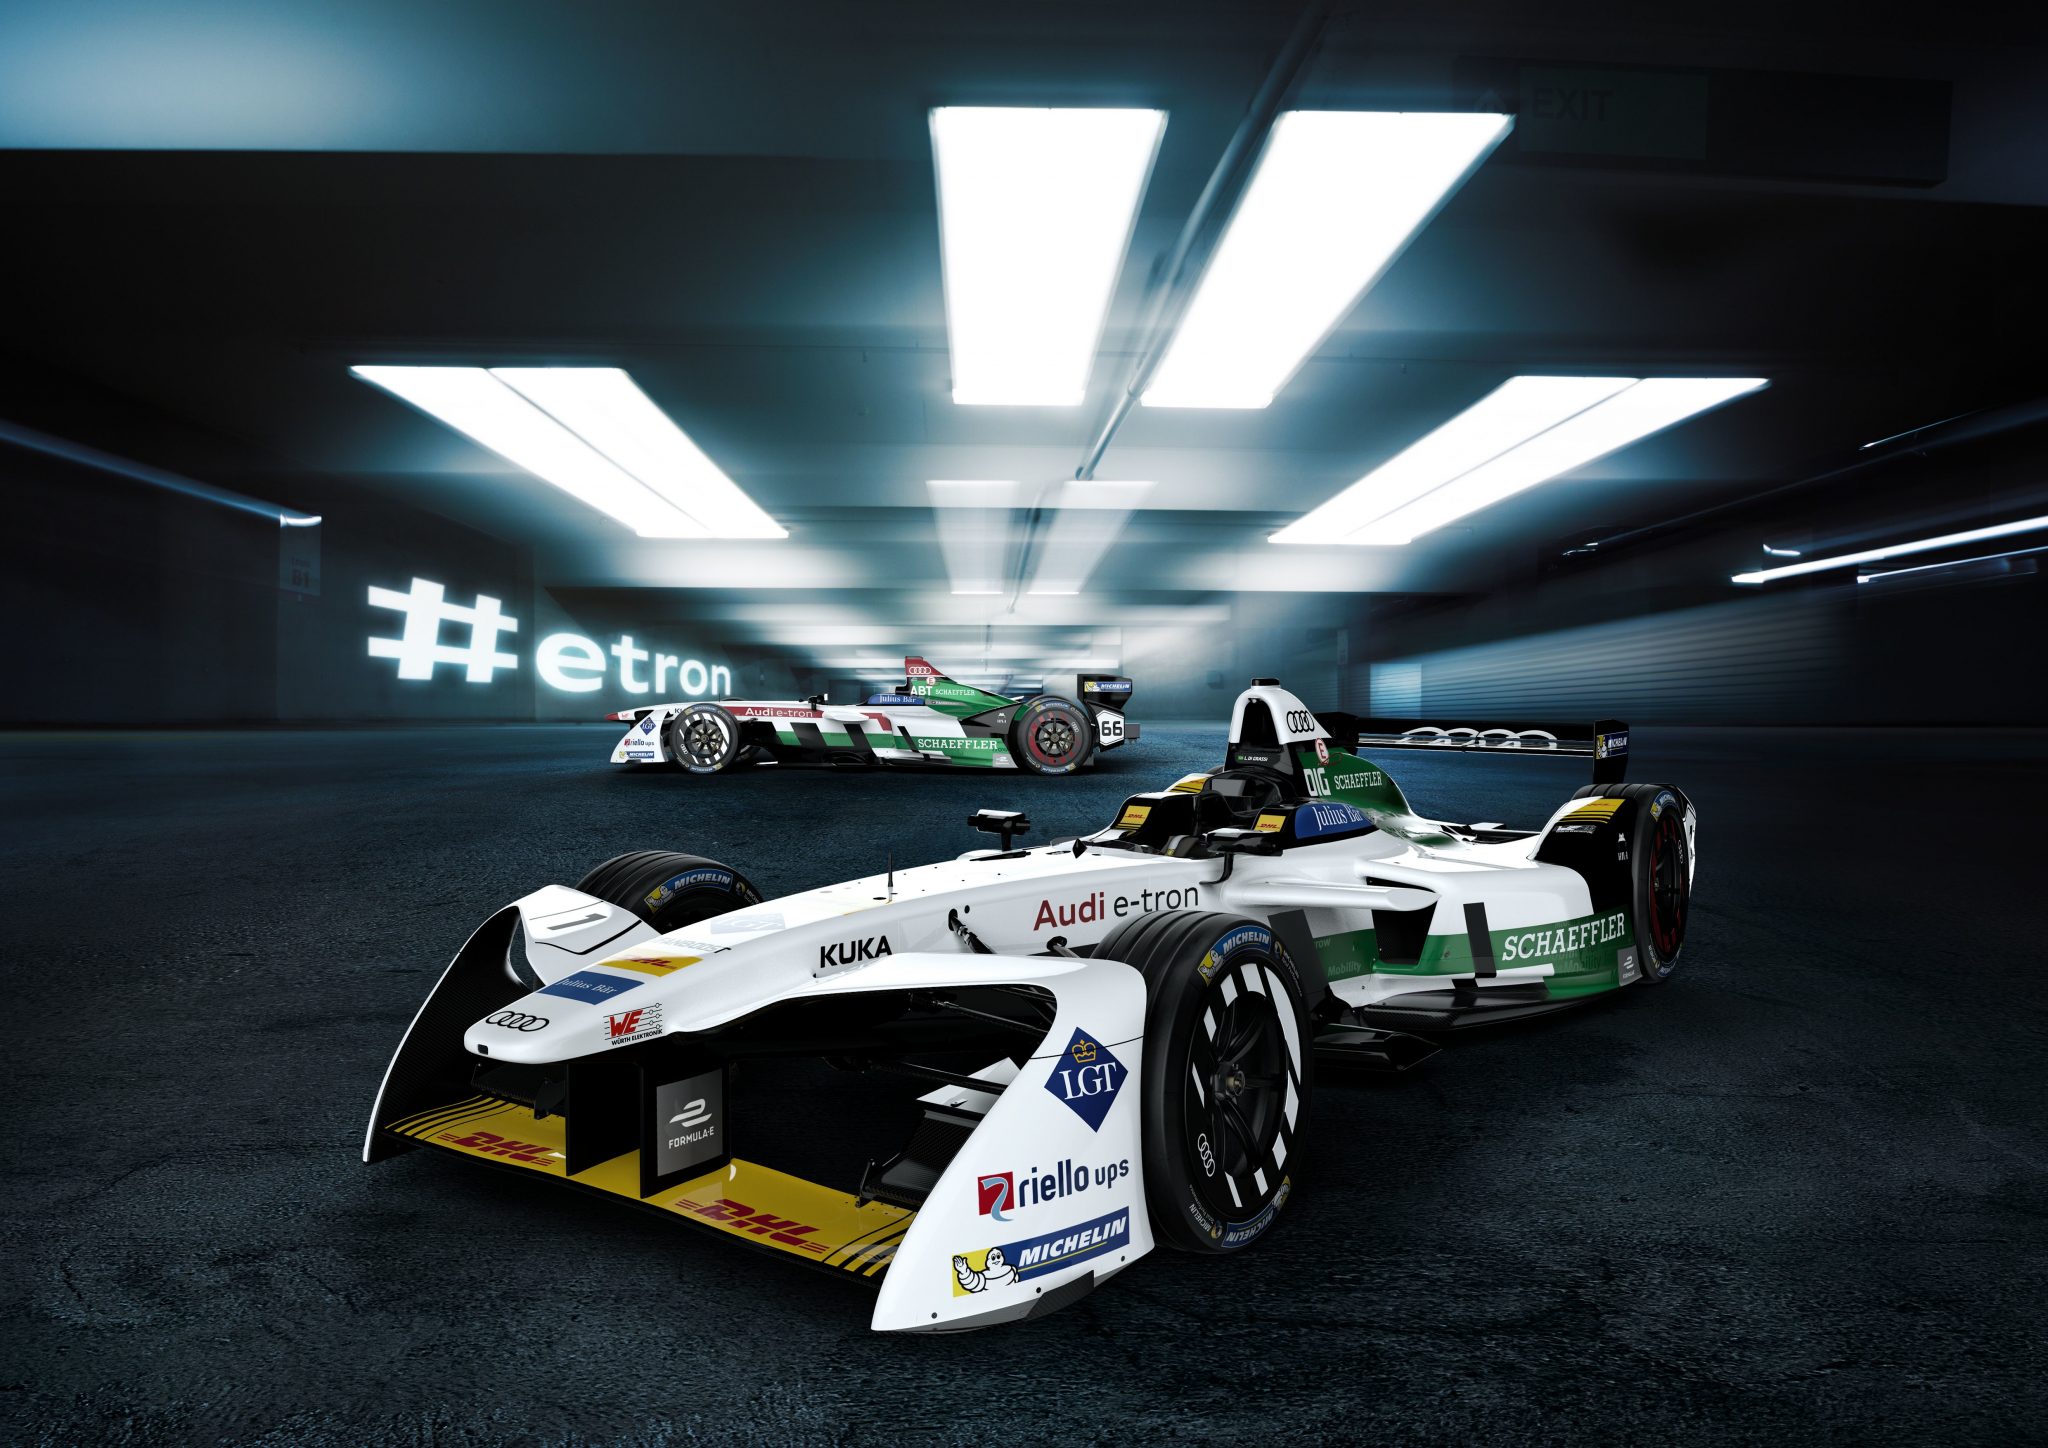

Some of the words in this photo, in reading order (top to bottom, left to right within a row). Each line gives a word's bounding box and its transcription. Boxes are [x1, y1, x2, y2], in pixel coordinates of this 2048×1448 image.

[1532, 87, 1614, 122] EXIT
[880, 694, 901, 703] Julius
[910, 686, 933, 696] ABT
[935, 689, 976, 697] SCHAEFFLER
[745, 707, 774, 717] Audi
[776, 709, 813, 718] e-tron
[1102, 720, 1123, 737] 66
[918, 738, 998, 750] SCHAEFFLER
[1303, 767, 1332, 797] DIG
[1333, 771, 1383, 790] SCHAEFFLER
[1312, 805, 1348, 831] Julius
[674, 873, 732, 890] MICHELIN
[1033, 892, 1106, 931] Audi
[1113, 884, 1200, 918] e-tron
[819, 935, 893, 968] KUKA
[1223, 931, 1271, 953] MICHELIN
[1501, 912, 1626, 962] SCHAEFFLER
[555, 978, 593, 989] Julius
[609, 1009, 644, 1037] WE
[611, 1036, 631, 1046] WÜRTH
[631, 1028, 663, 1042] ELEKTRONIK
[1059, 1061, 1118, 1100] LGT
[453, 1131, 555, 1163] DHL
[1019, 1158, 1089, 1208] riello
[1095, 1159, 1130, 1189] ups
[695, 1199, 821, 1247] DHL
[1226, 1210, 1275, 1243] MICHELIN
[1018, 1216, 1128, 1268] MICHELIN
